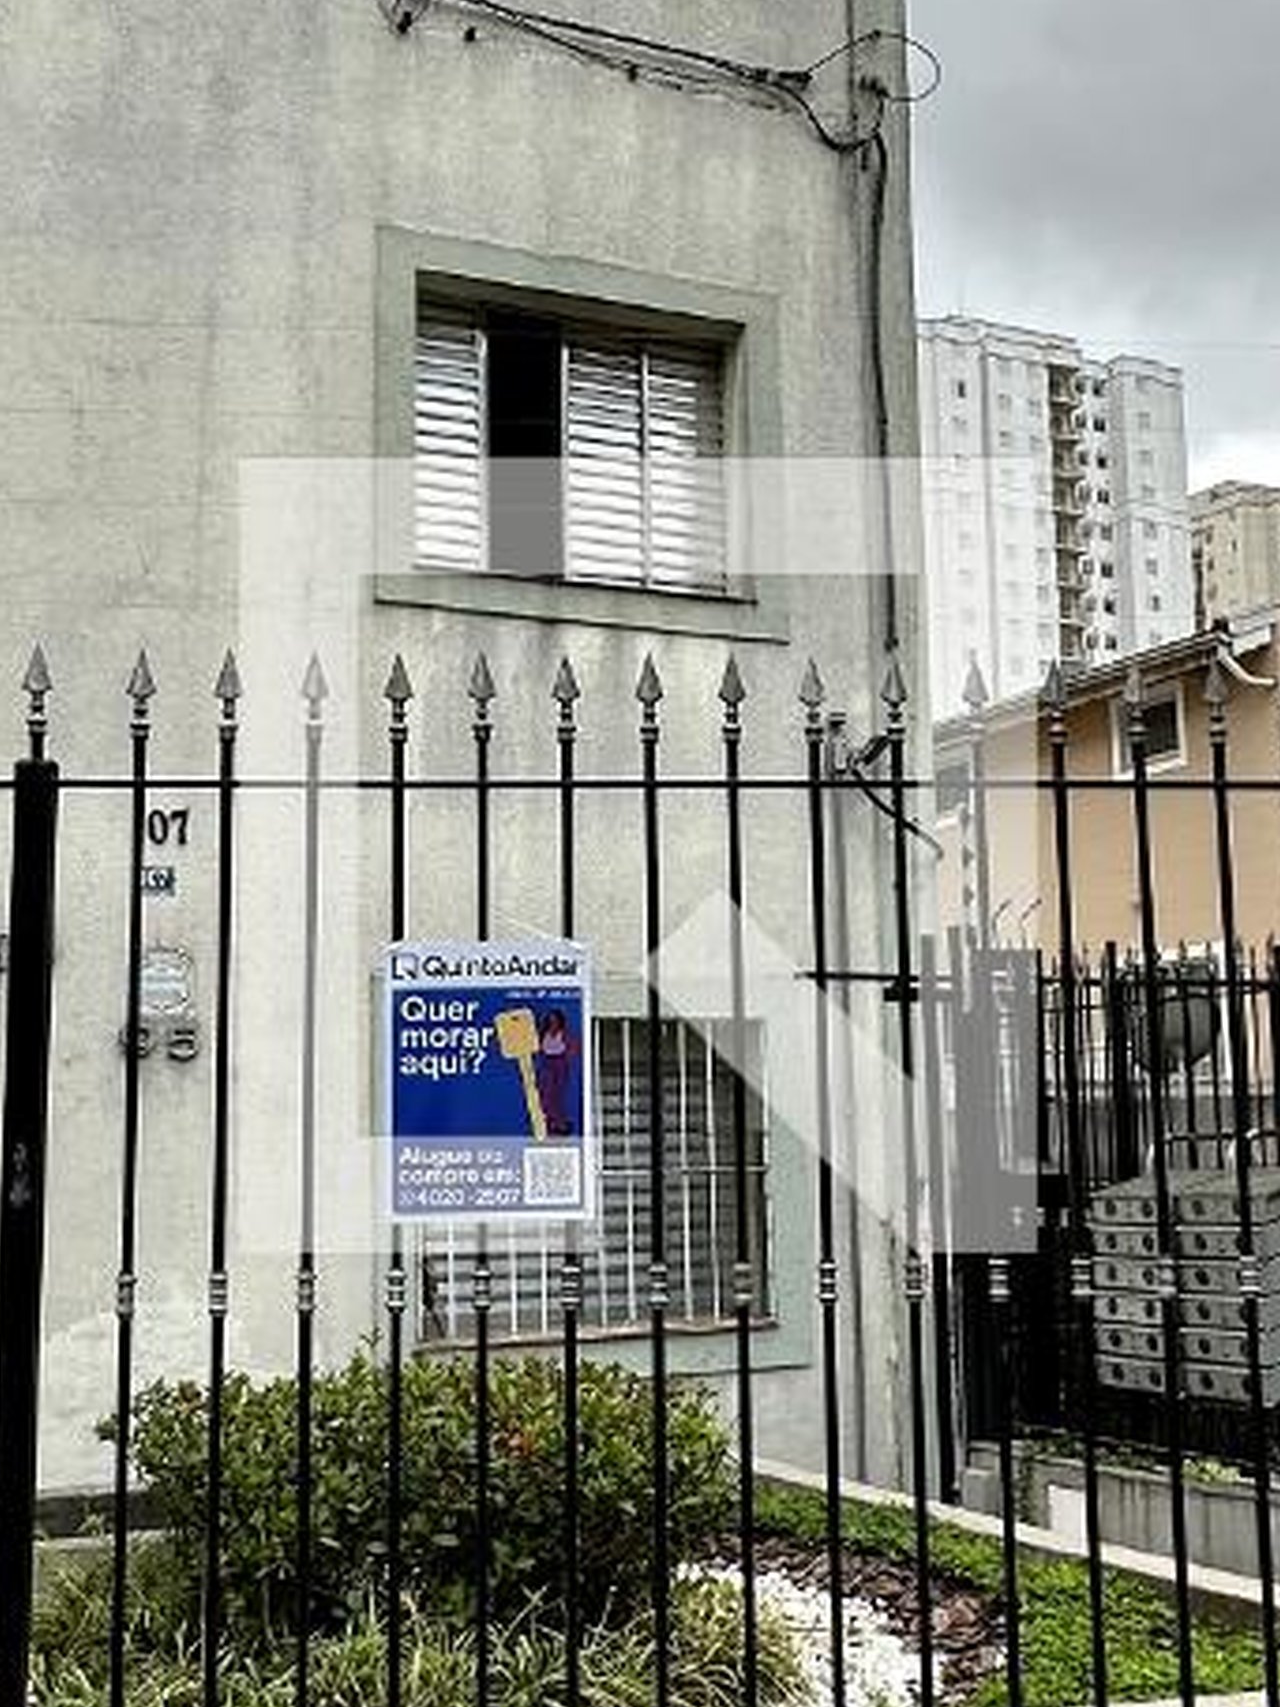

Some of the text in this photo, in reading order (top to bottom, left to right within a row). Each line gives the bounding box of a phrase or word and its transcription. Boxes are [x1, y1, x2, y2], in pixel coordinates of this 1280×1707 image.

[421, 954, 578, 979] QuintoAndar
[400, 996, 479, 1022] Quer
[400, 1026, 494, 1049] morar
[400, 1048, 486, 1081] aqui?
